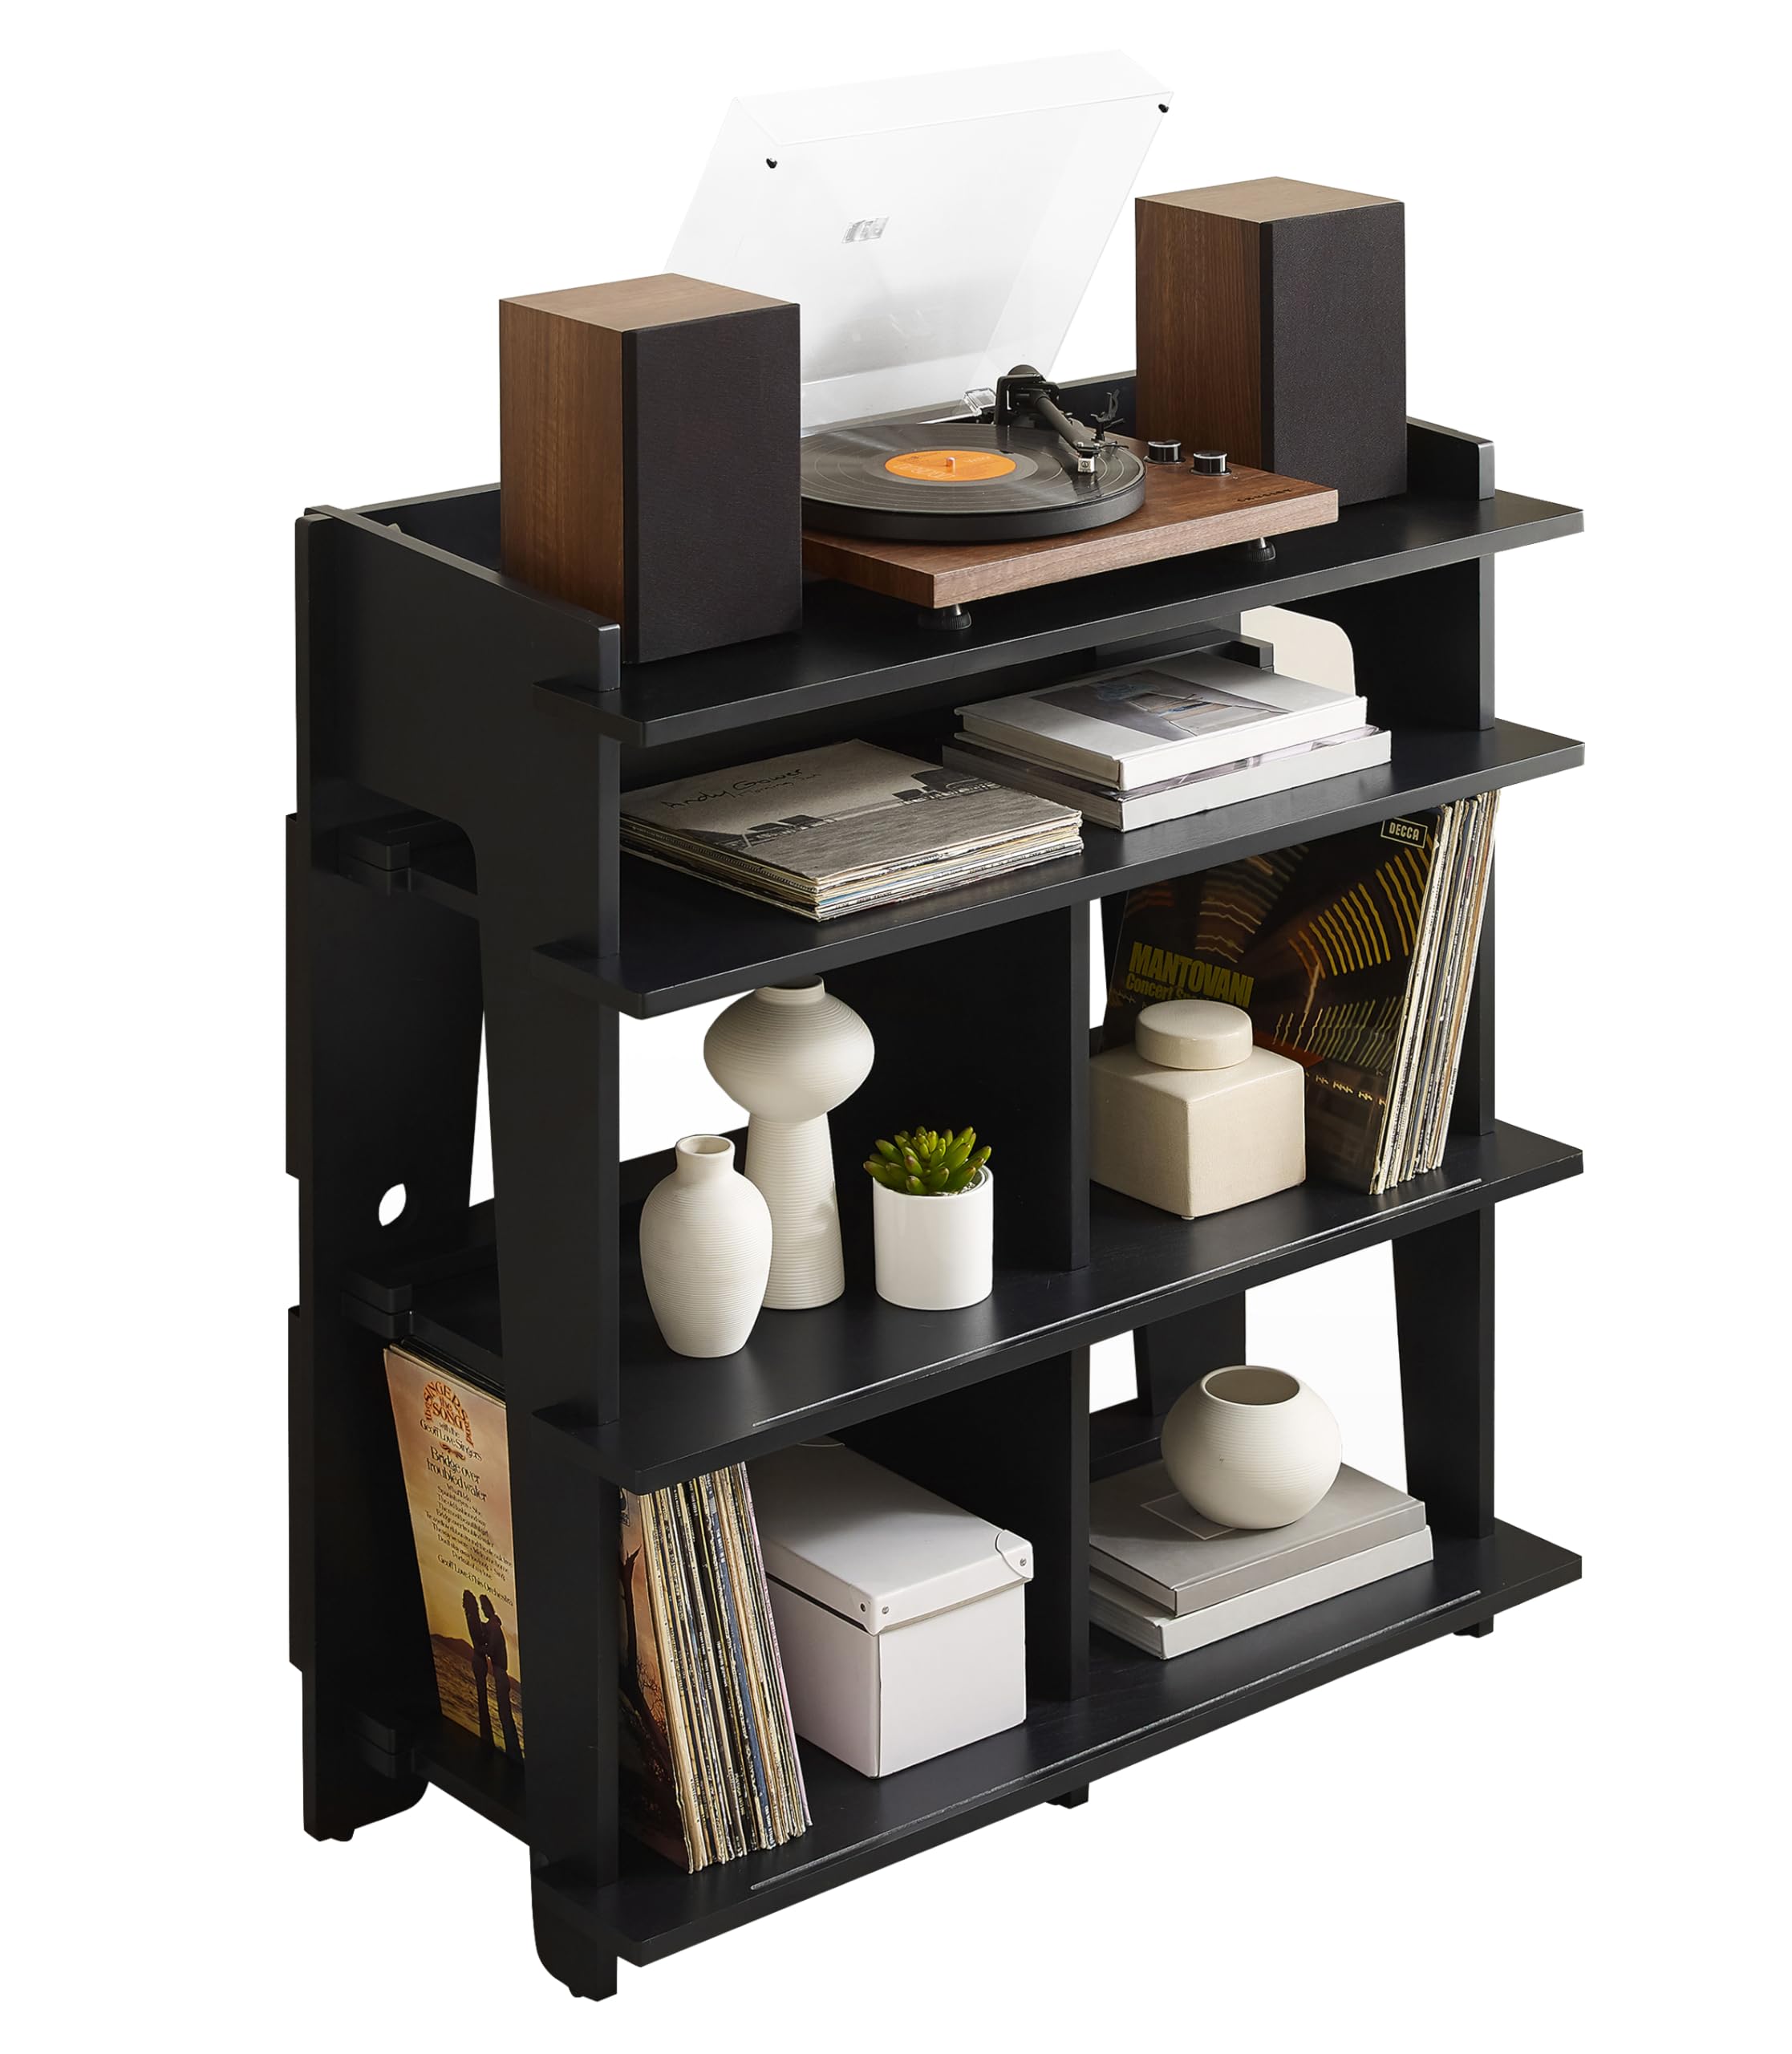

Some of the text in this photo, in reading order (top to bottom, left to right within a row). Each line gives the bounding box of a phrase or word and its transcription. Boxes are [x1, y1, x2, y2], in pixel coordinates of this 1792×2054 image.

[1389, 822, 1420, 841] DECCA
[1126, 972, 1174, 1001] Concert
[1129, 941, 1255, 1009] MANTOVANI
[432, 1401, 464, 1431] SONG
[426, 1457, 488, 1503] troubled water
[430, 1446, 480, 1484] Bridge over
